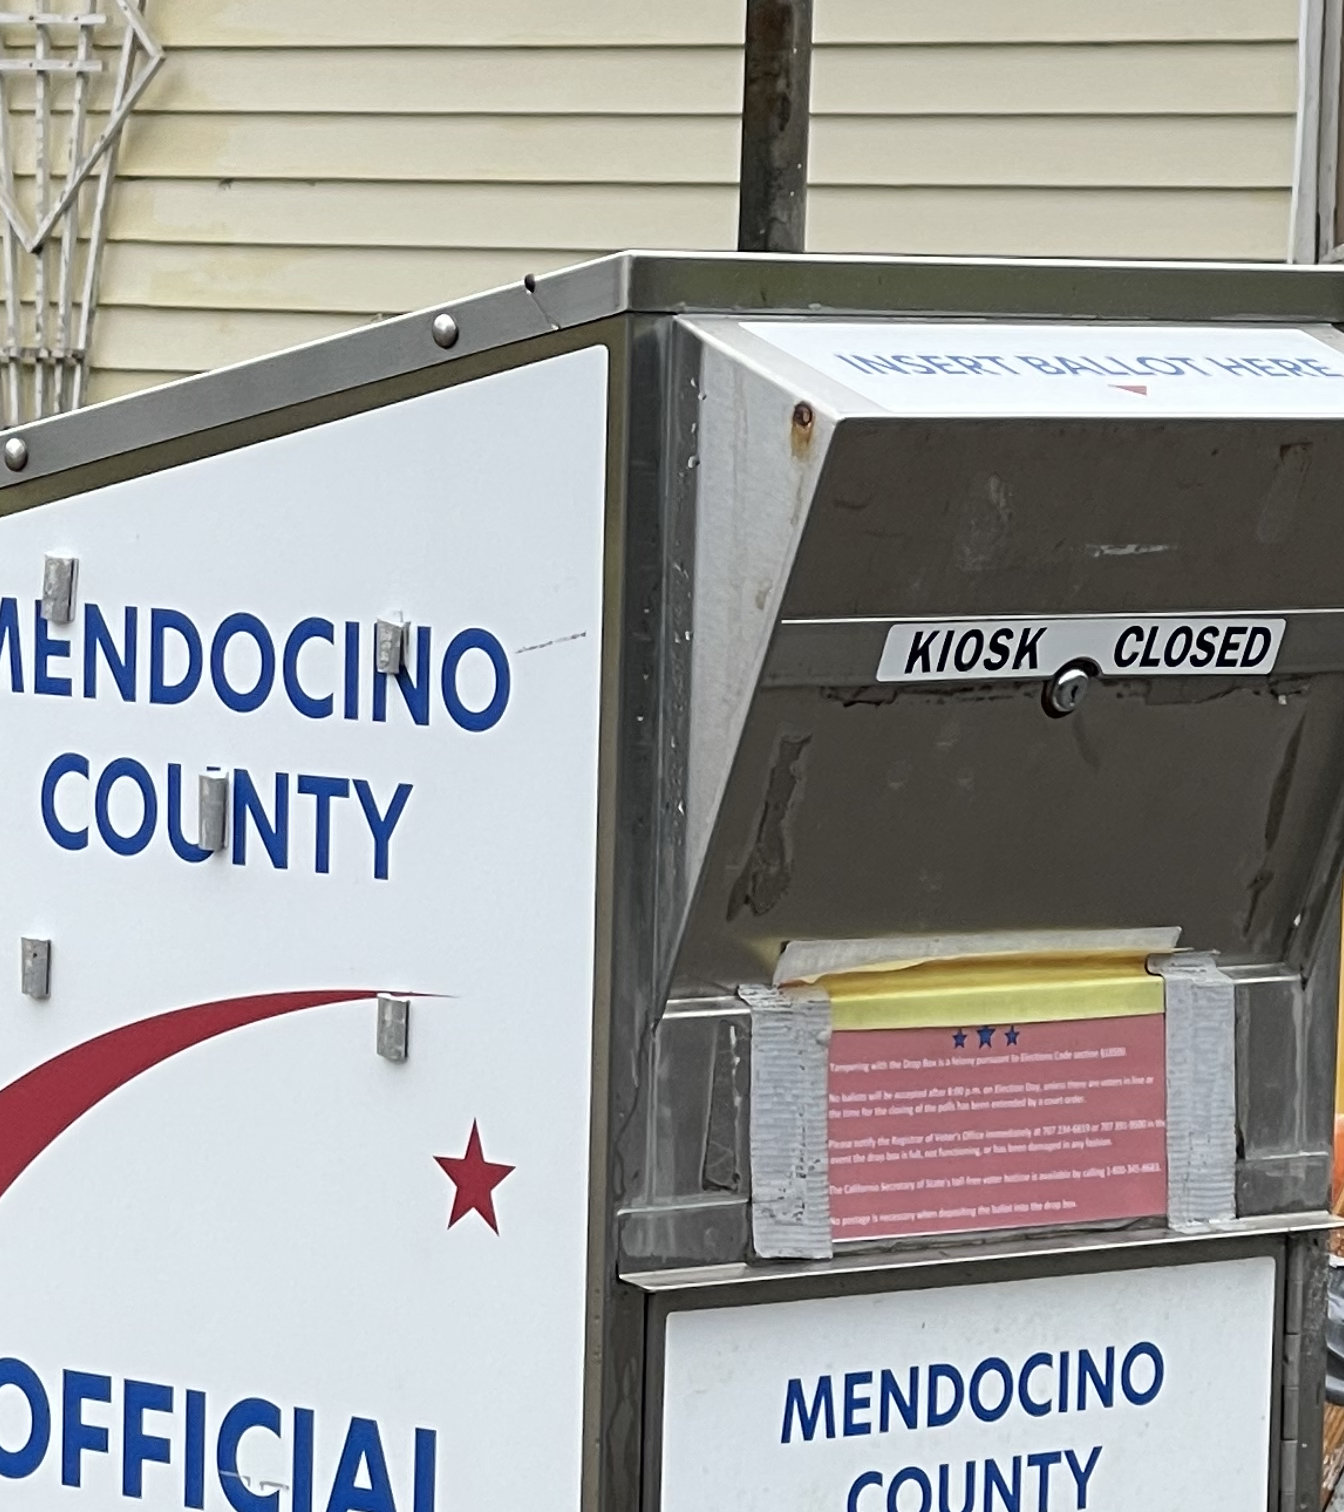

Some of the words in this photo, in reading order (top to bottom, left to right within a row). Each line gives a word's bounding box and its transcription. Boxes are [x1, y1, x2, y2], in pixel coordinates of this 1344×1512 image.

[834, 354, 1021, 376] INSERT
[1013, 355, 1210, 376] BALLOT
[1206, 357, 1343, 377] HERE
[904, 626, 1048, 674] KIOSK
[1113, 625, 1272, 668] CLOSED
[42, 754, 412, 878] COUNTY
[782, 1342, 1163, 1443] MENDOCINO
